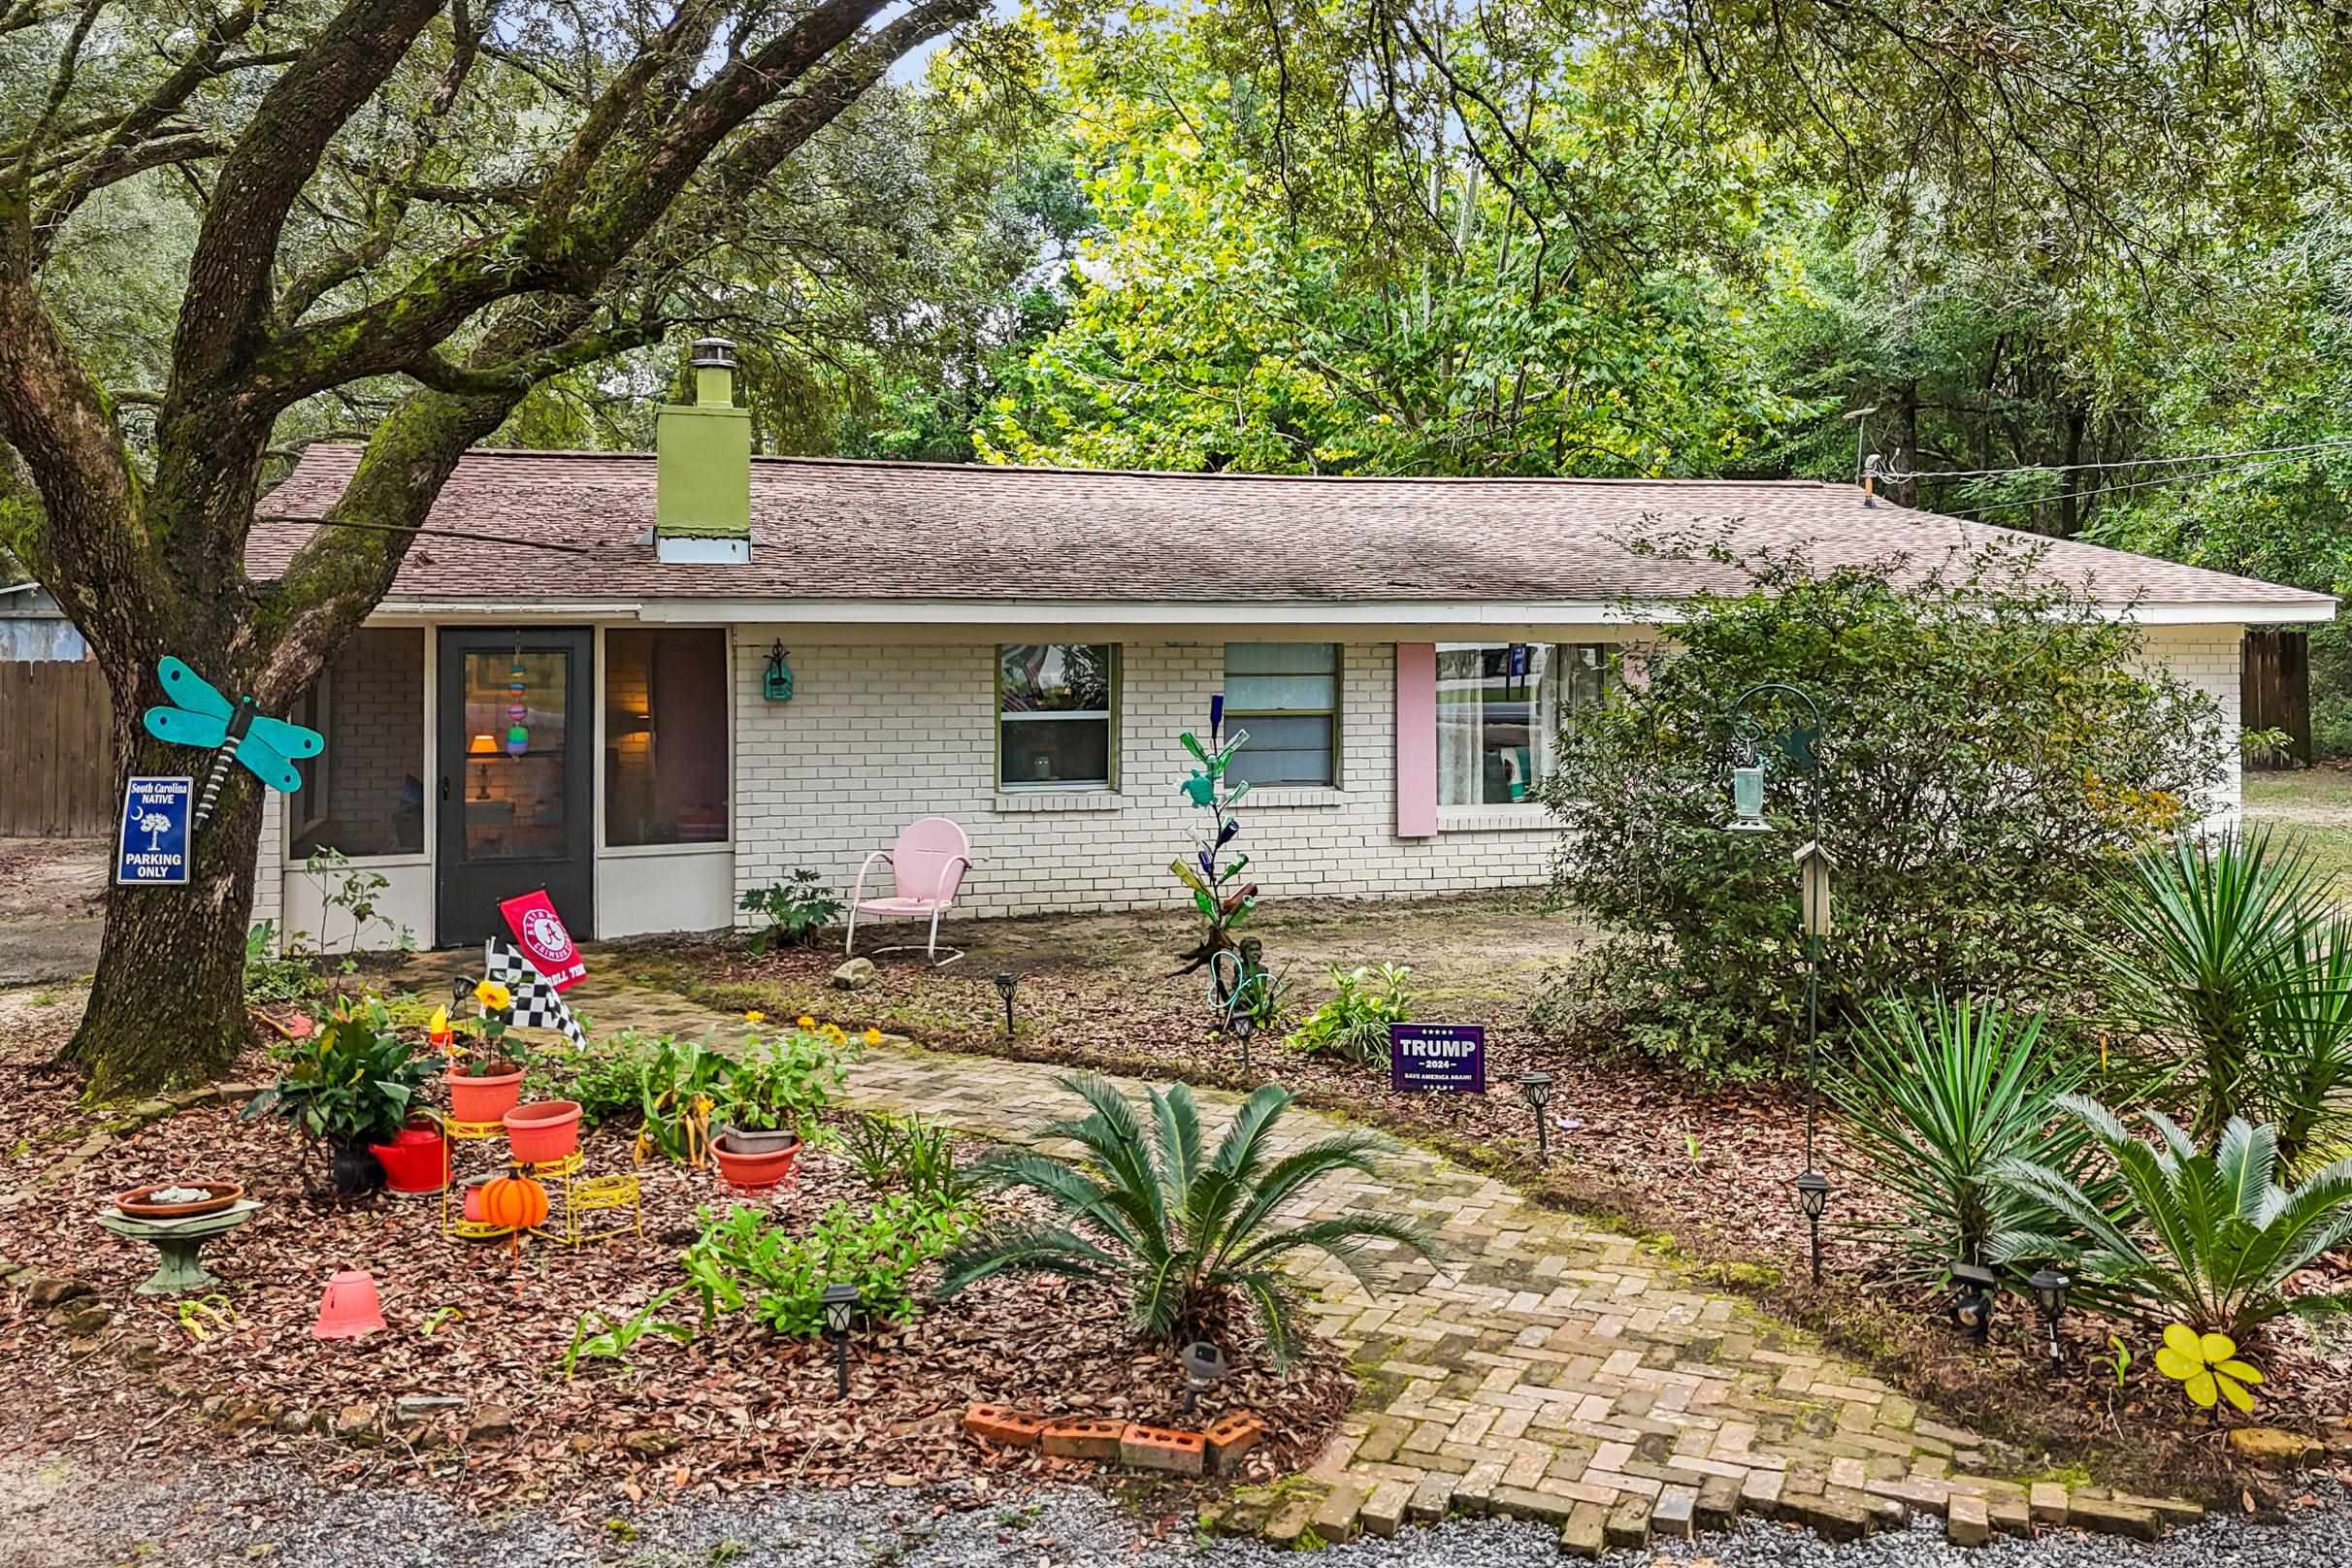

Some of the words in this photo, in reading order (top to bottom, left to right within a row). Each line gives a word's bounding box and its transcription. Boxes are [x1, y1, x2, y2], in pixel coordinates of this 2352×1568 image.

[131, 782, 153, 794] South
[154, 782, 187, 794] Carolina
[142, 794, 176, 804] NATIVE
[125, 853, 181, 866] PARKING
[137, 866, 169, 878] ONLY
[1399, 1039, 1476, 1058] TRUMP
